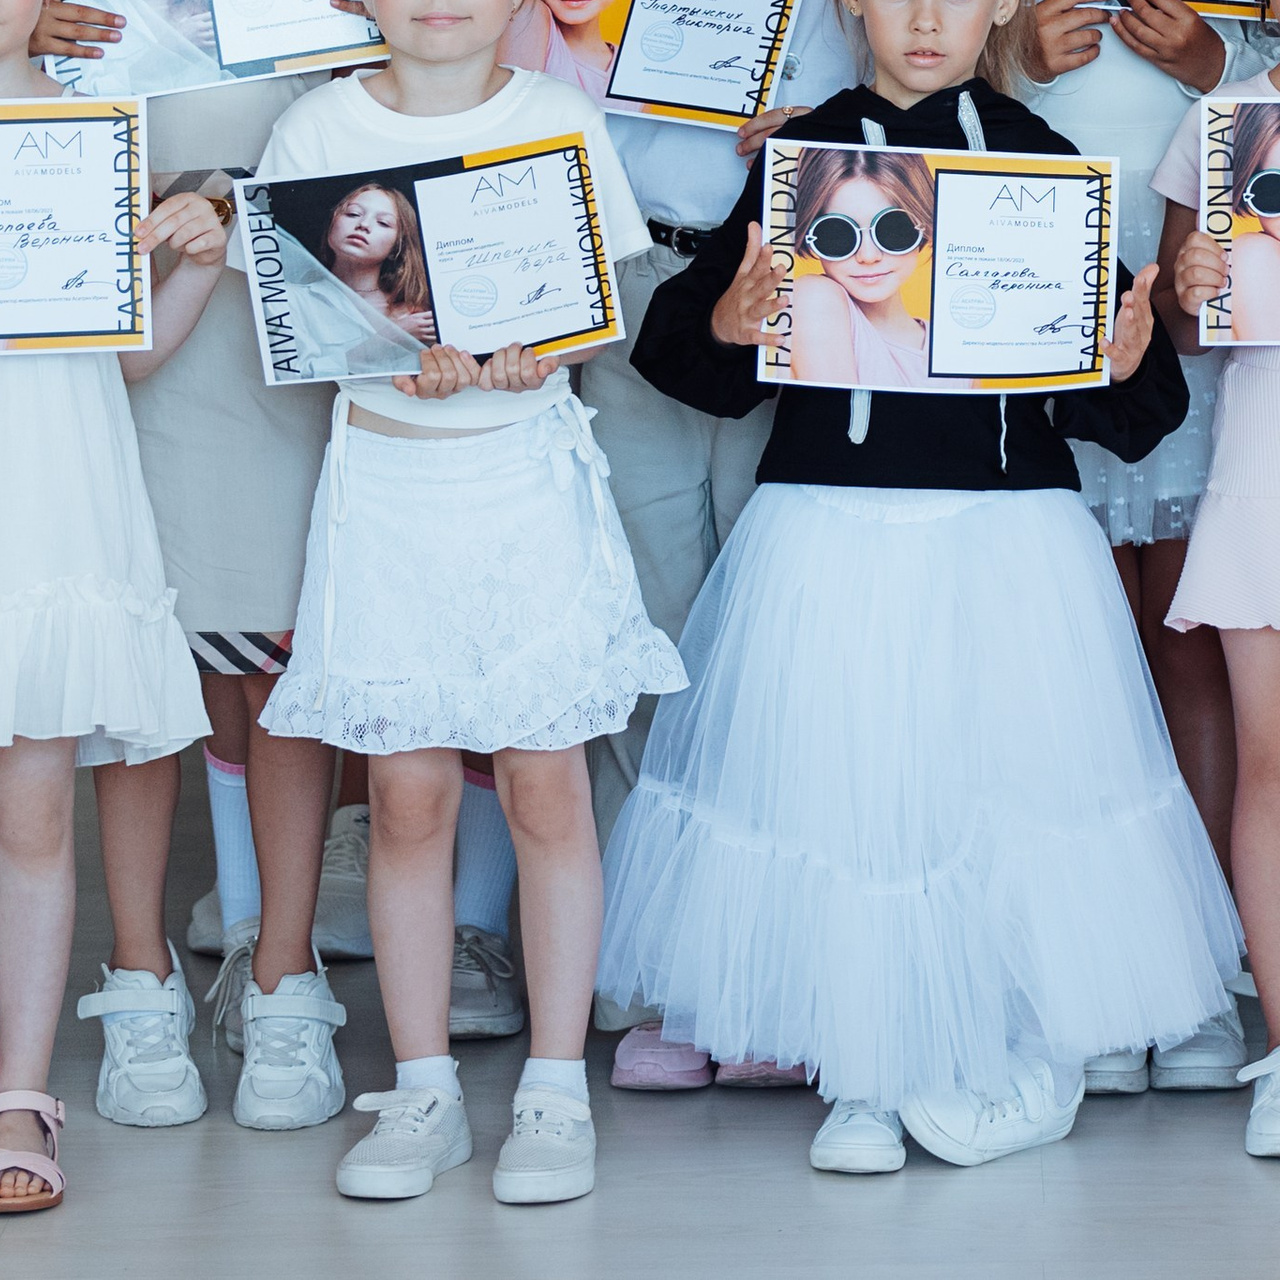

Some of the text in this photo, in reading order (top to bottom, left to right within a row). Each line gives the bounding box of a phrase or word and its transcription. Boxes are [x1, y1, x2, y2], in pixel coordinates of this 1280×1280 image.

[14, 131, 82, 160] AM
[1207, 107, 1235, 173] DAY
[14, 167, 82, 176] AIVAMODELS
[470, 166, 536, 203] AM
[771, 148, 799, 219] DAY
[473, 198, 538, 217] AIVAMODELS
[989, 184, 1056, 213] AM
[113, 106, 144, 335] FASHION DAY
[989, 219, 1055, 228] AIVAMODELS
[13, 233, 112, 249] Вероника
[436, 237, 474, 250] Диплом
[563, 147, 616, 326] FASHION KIDS
[946, 243, 985, 253] Диплом
[246, 185, 300, 374] AIVA MODELS
[1079, 165, 1112, 371] FASHION DAY
[988, 279, 1064, 292] Вероника
